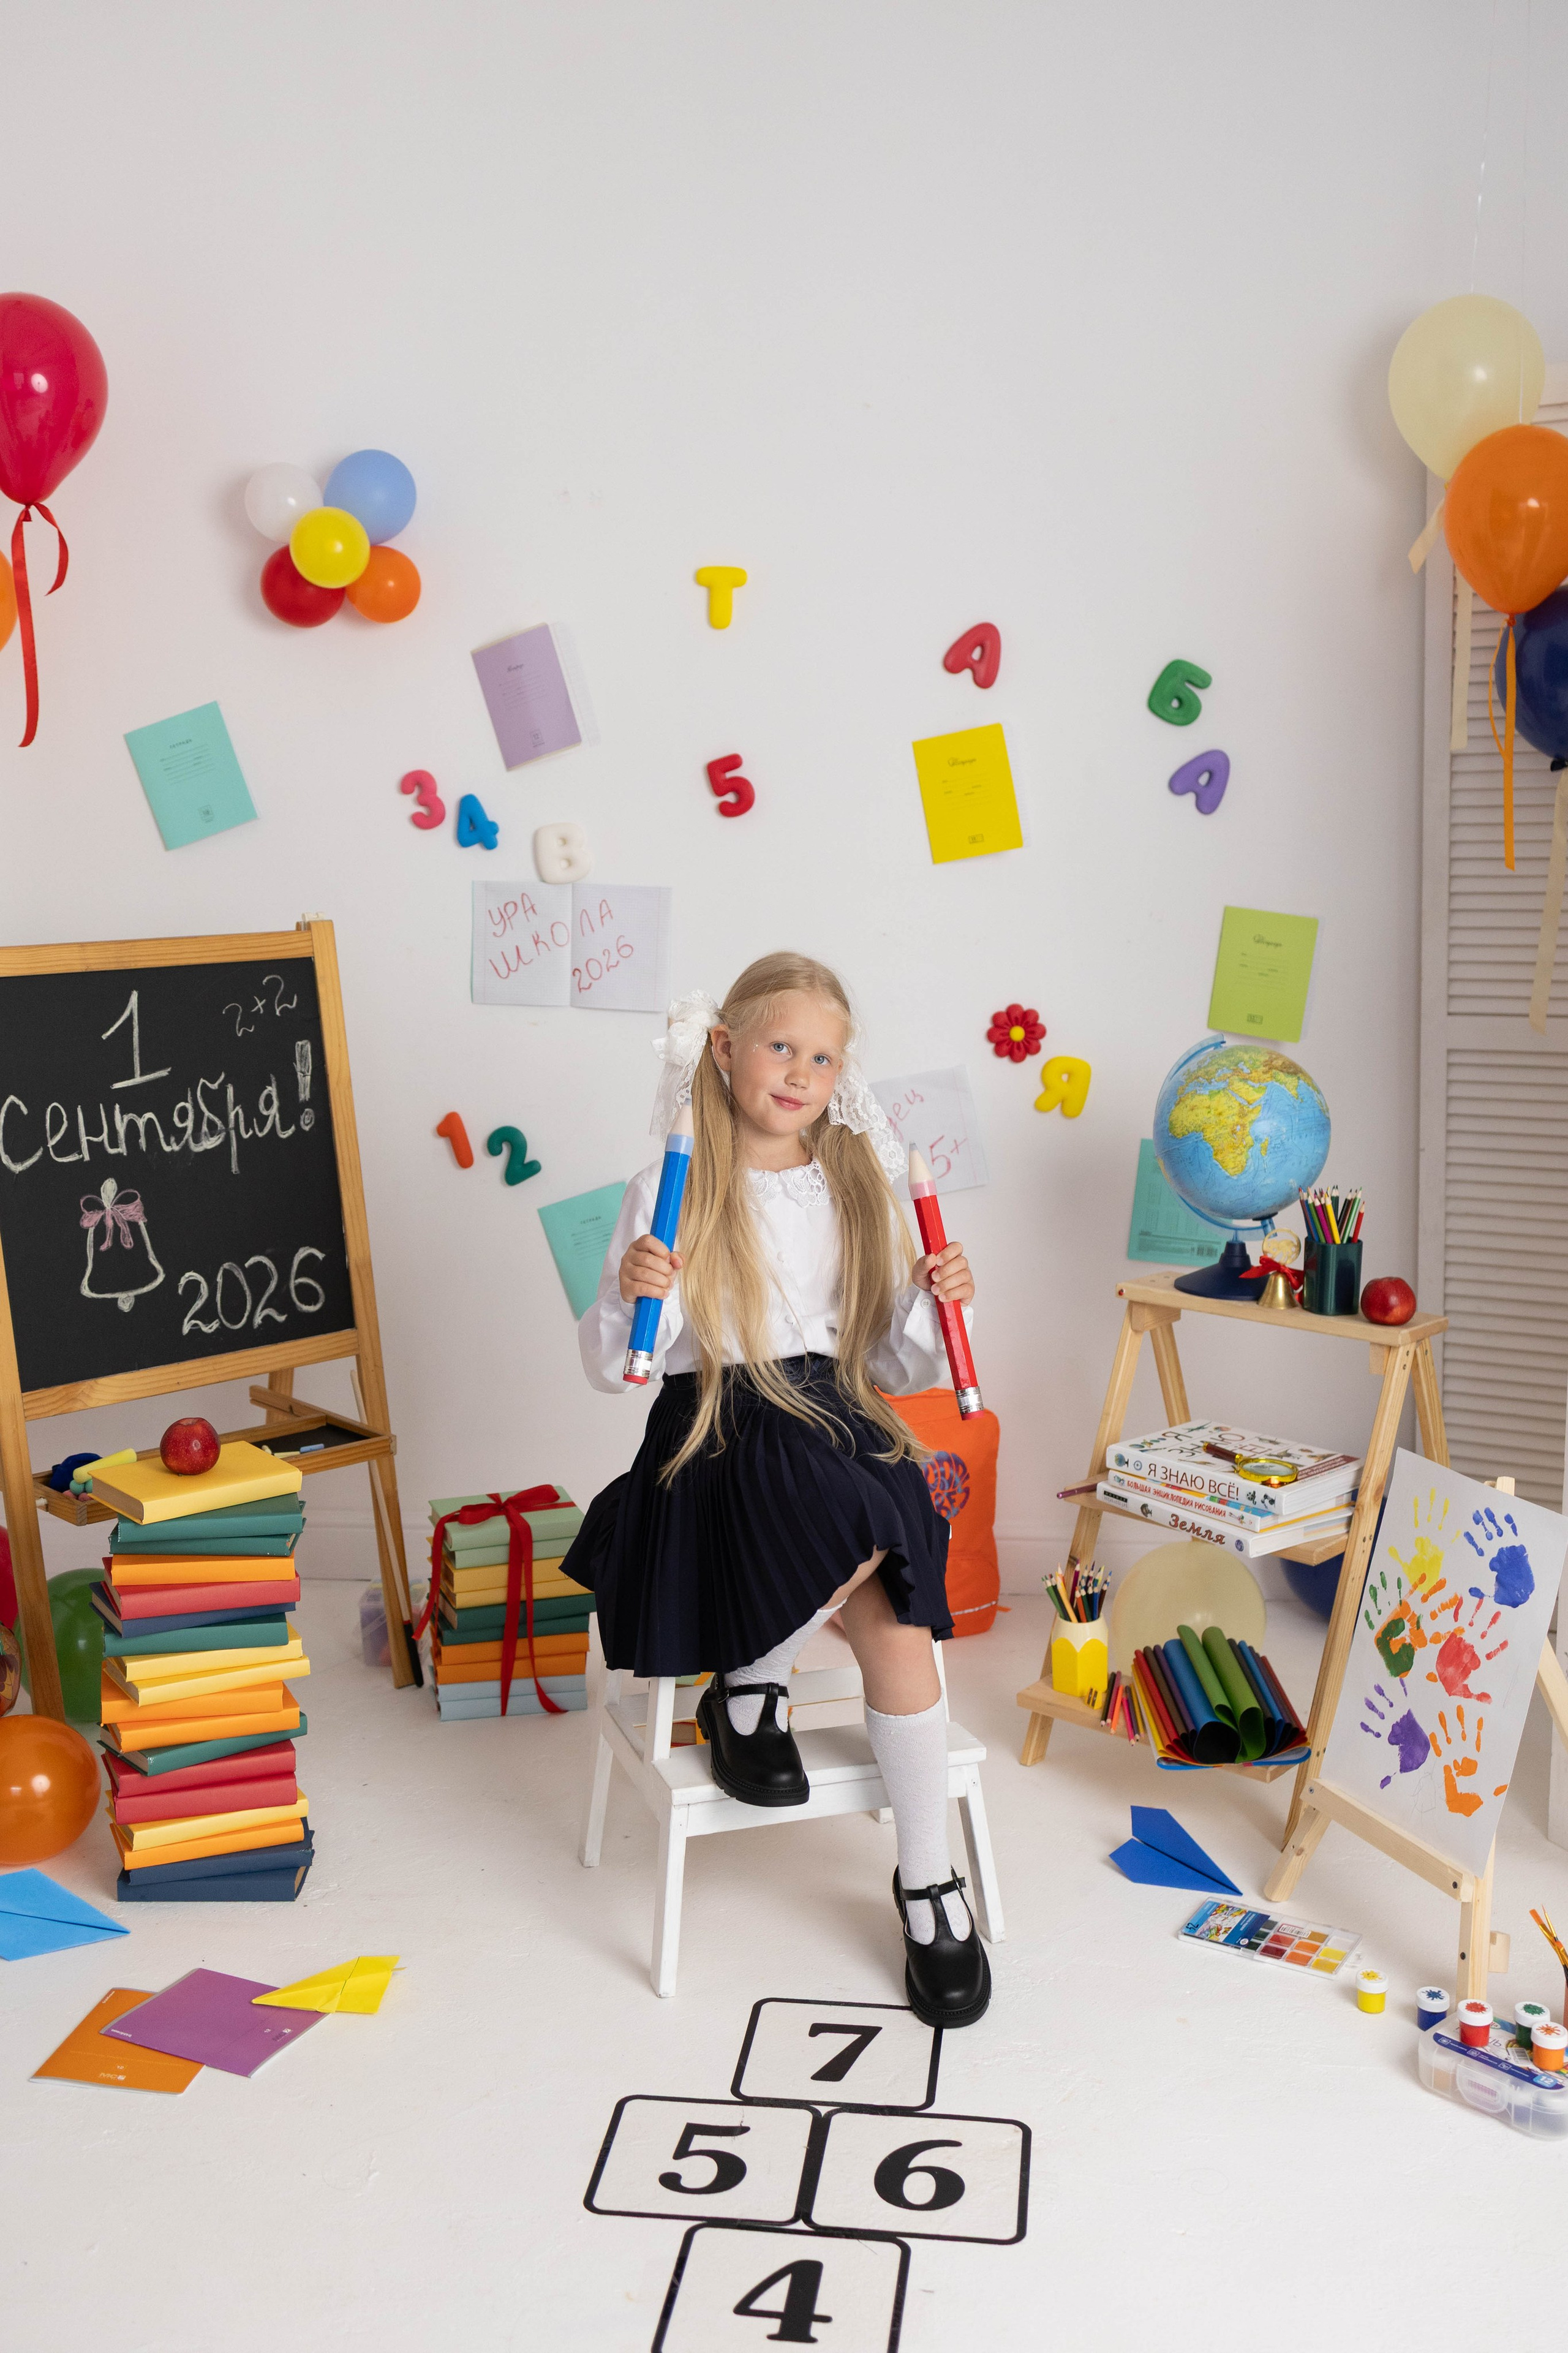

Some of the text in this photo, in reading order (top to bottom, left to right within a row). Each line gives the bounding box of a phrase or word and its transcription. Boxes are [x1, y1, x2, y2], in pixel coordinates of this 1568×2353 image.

[706, 753, 755, 817] 5
[488, 893, 538, 937] УРА
[488, 899, 613, 979] ШКОЛА
[572, 935, 633, 993] 2026
[101, 989, 172, 1089] 1
[1033, 1055, 1091, 1119] Я
[436, 1111, 474, 1169] 1
[487, 1125, 541, 1186] 2
[929, 1135, 968, 1179] 5+
[178, 1246, 326, 1335] 2026
[1168, 1433, 1245, 1457] ЗНЮ
[1127, 1479, 1226, 1517] БОЛЬШАЯ ЭНЦИКЛОПЕДИЯ РИСОВАНИЯ
[1148, 1463, 1239, 1500] Я ЗНАЮ ВСЁ!
[1169, 1513, 1226, 1545] Земля
[809, 2023, 882, 2082] 7
[1540, 2075, 1554, 2085] 12
[658, 2122, 965, 2210] 5 6
[733, 2259, 833, 2343] 4
